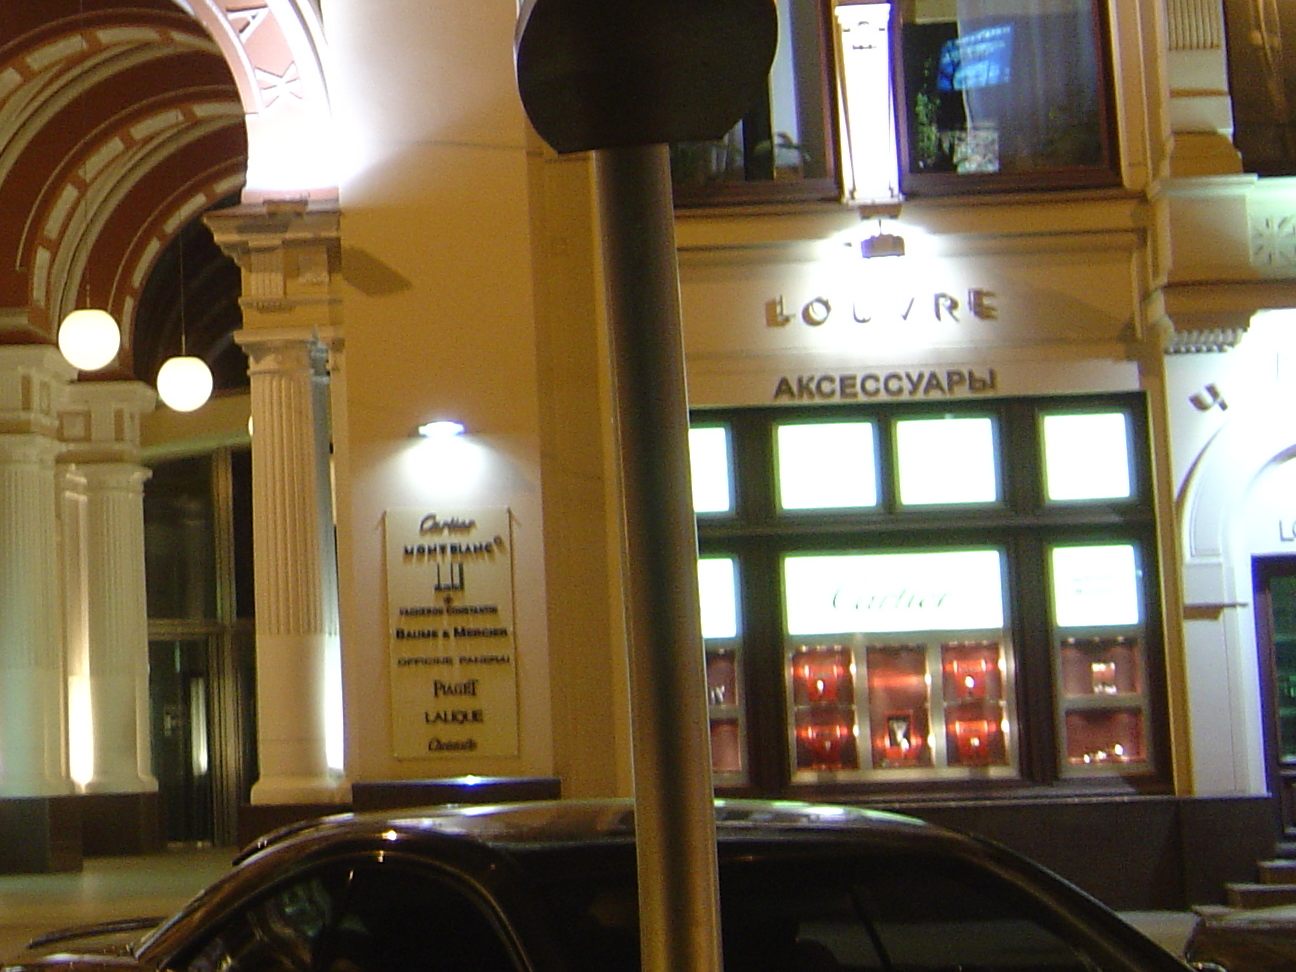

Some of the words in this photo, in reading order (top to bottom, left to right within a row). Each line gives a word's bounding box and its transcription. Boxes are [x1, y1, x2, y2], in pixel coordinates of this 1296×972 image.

[765, 287, 999, 327] LOUVRE
[773, 368, 998, 400] АКСЕССУАРЫ
[425, 709, 483, 725] LALIQUE
